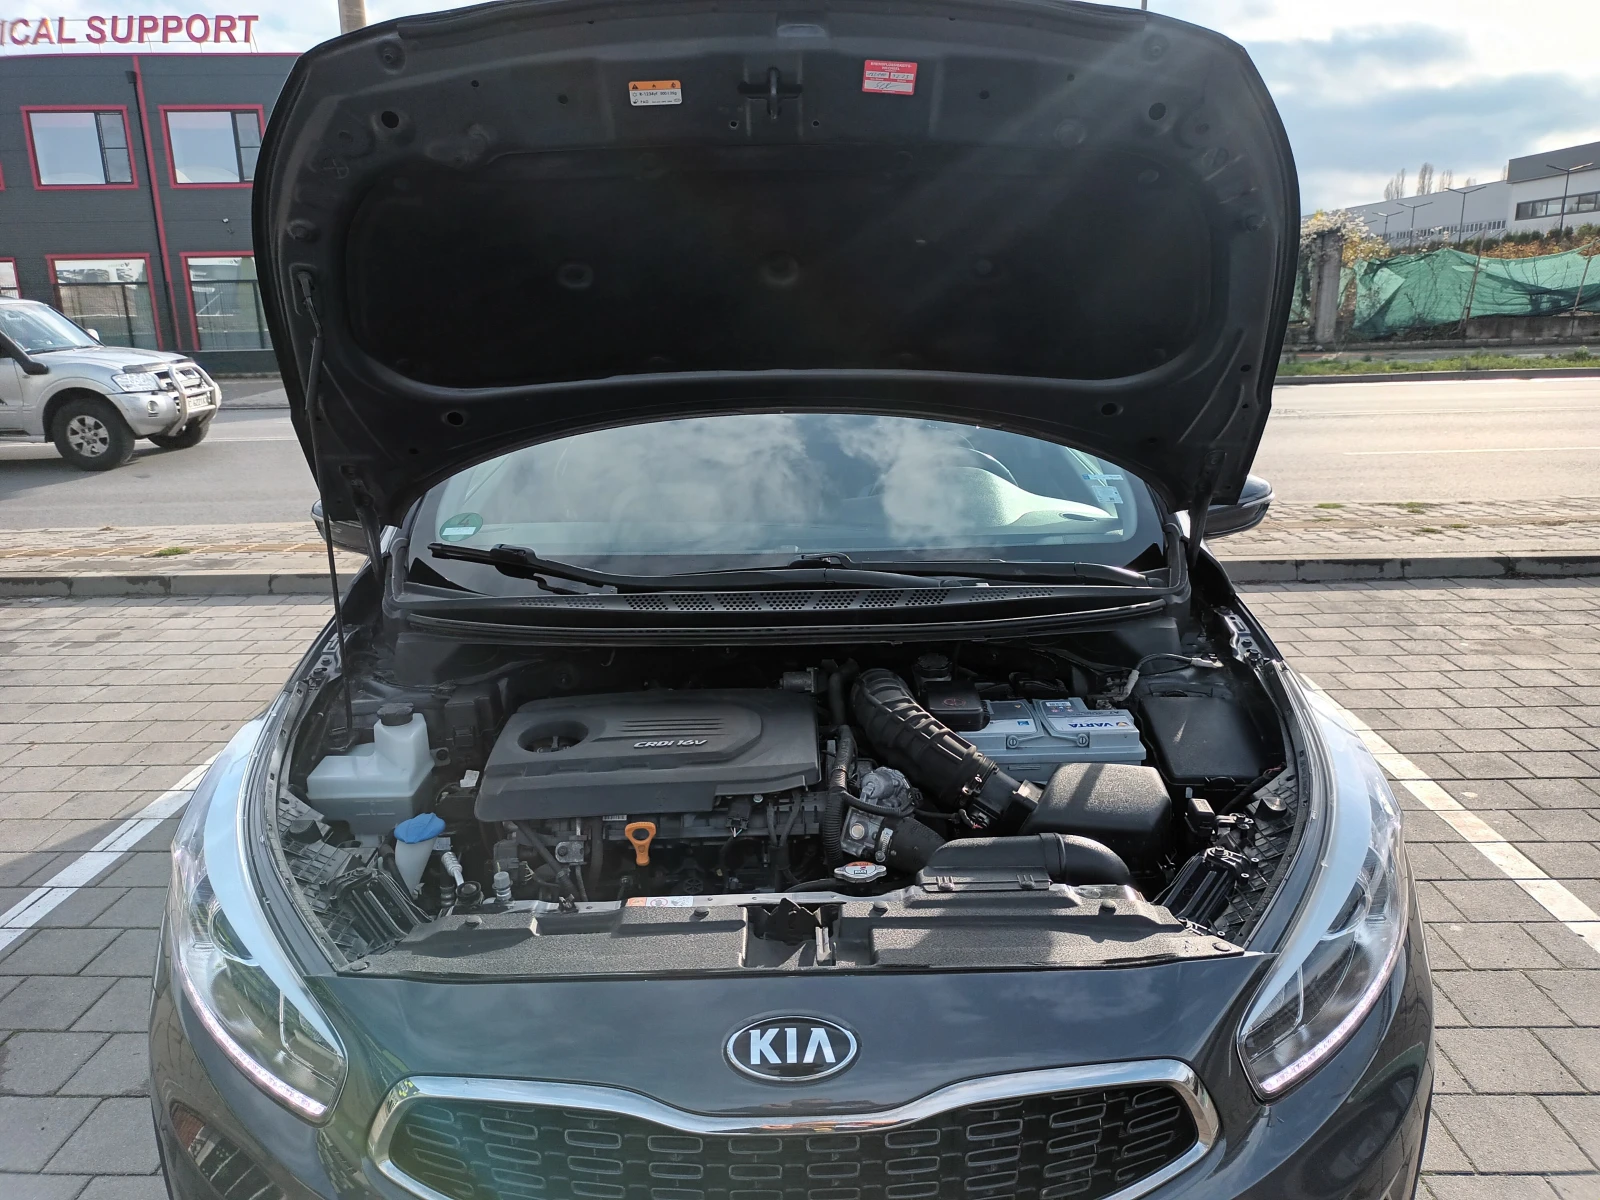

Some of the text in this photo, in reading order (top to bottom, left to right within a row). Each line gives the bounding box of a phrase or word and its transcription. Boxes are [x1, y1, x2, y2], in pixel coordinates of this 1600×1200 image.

[86, 14, 259, 44] SUPPORT
[676, 739, 708, 747] 16V
[749, 1027, 836, 1065] KIA
